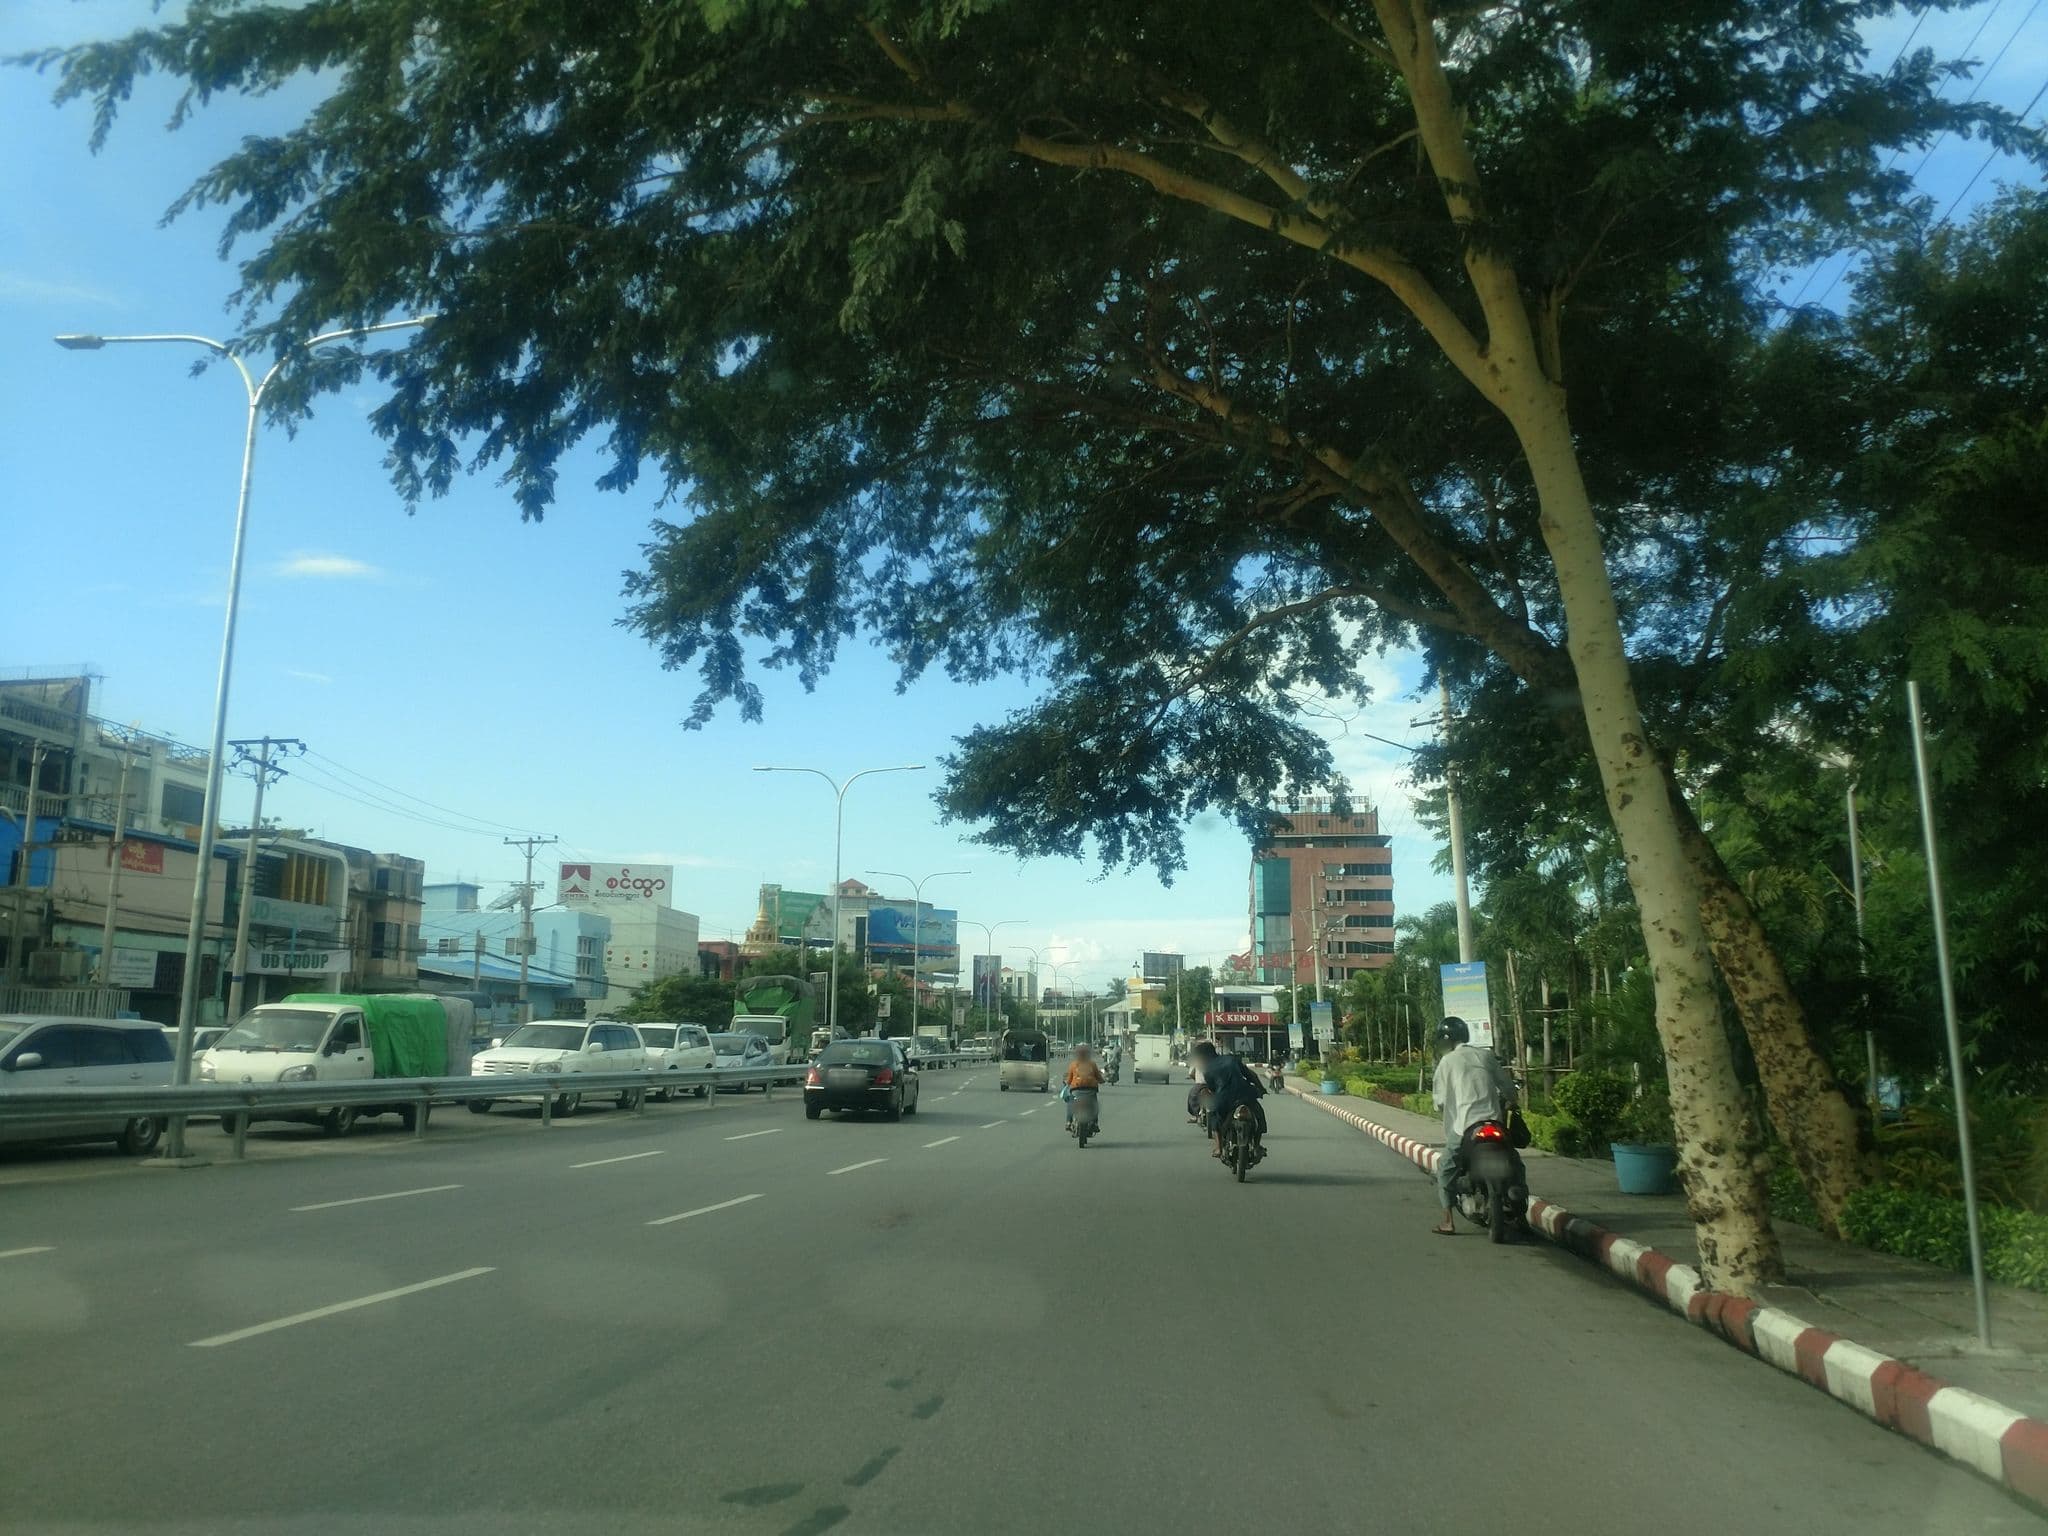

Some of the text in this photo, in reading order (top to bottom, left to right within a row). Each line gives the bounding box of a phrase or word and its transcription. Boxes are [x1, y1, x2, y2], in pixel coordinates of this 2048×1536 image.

[261, 953, 329, 969] UD GROUP
[1227, 1014, 1260, 1022] KENBO
